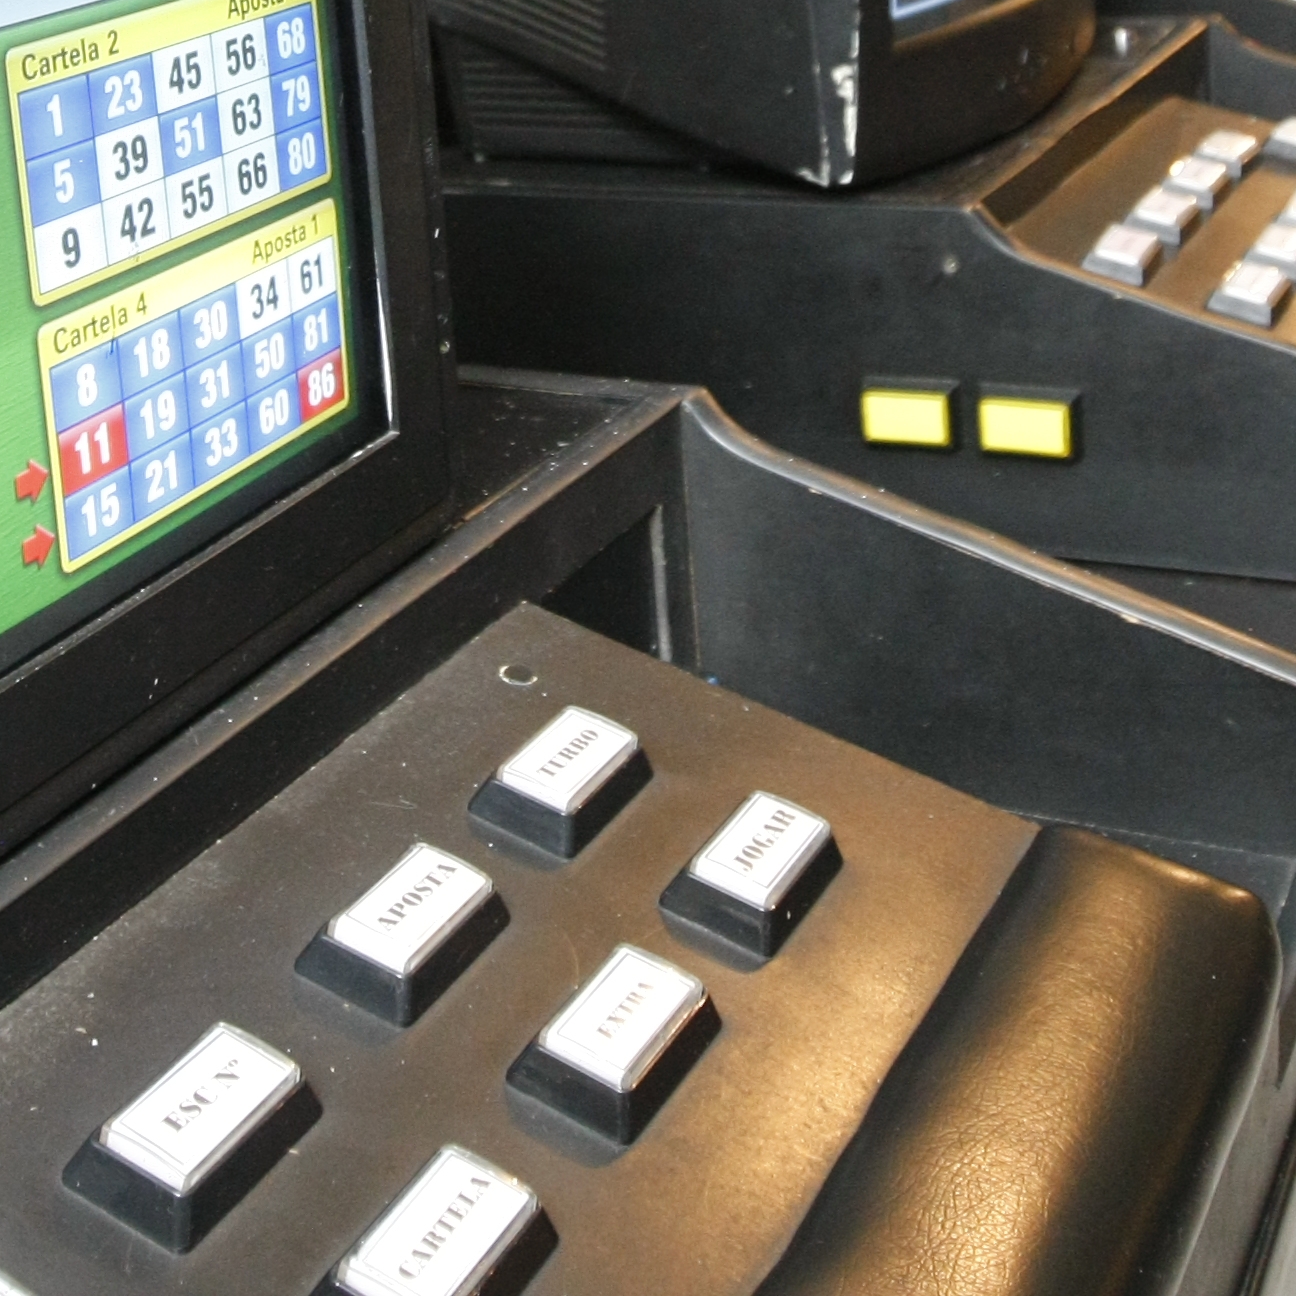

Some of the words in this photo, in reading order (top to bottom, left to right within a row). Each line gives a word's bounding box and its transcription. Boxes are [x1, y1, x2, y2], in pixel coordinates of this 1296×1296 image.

[22, 39, 100, 82] Cartela
[108, 30, 119, 56] 2
[46, 94, 64, 137] 1
[104, 70, 143, 119] 23
[169, 51, 202, 95] 45
[226, 34, 256, 76] 56
[276, 17, 305, 58] 68
[54, 159, 75, 204] 5
[112, 134, 148, 181] 39
[174, 112, 205, 159] 51
[231, 92, 262, 135] 63
[282, 75, 311, 116] 79
[62, 227, 81, 268] 9
[121, 198, 155, 243] 42
[181, 174, 214, 220] 55
[238, 153, 268, 196] 66
[287, 132, 316, 175] 80
[53, 304, 128, 354] Cartela
[136, 292, 148, 316] 4
[252, 228, 307, 265] Aposta
[311, 214, 320, 235] 1
[76, 363, 98, 406] 8
[133, 328, 170, 378] 18
[193, 301, 228, 349] 30
[251, 276, 279, 319] 34
[300, 253, 323, 294] 61
[75, 422, 110, 475] 11
[140, 390, 176, 439] 19
[199, 360, 230, 408] 31
[255, 333, 284, 379] 50
[304, 308, 329, 352] 81
[82, 482, 120, 537] 15
[145, 450, 178, 500] 21
[204, 418, 238, 467] 33
[259, 388, 289, 435] 60
[308, 362, 335, 406] 86
[536, 729, 599, 779] TURBO
[733, 809, 796, 872] JOGAR
[377, 863, 458, 932] APOSTA
[597, 981, 654, 1040] EXTRA
[160, 1085, 219, 1134] ESC
[398, 1175, 492, 1281] CARTELA
